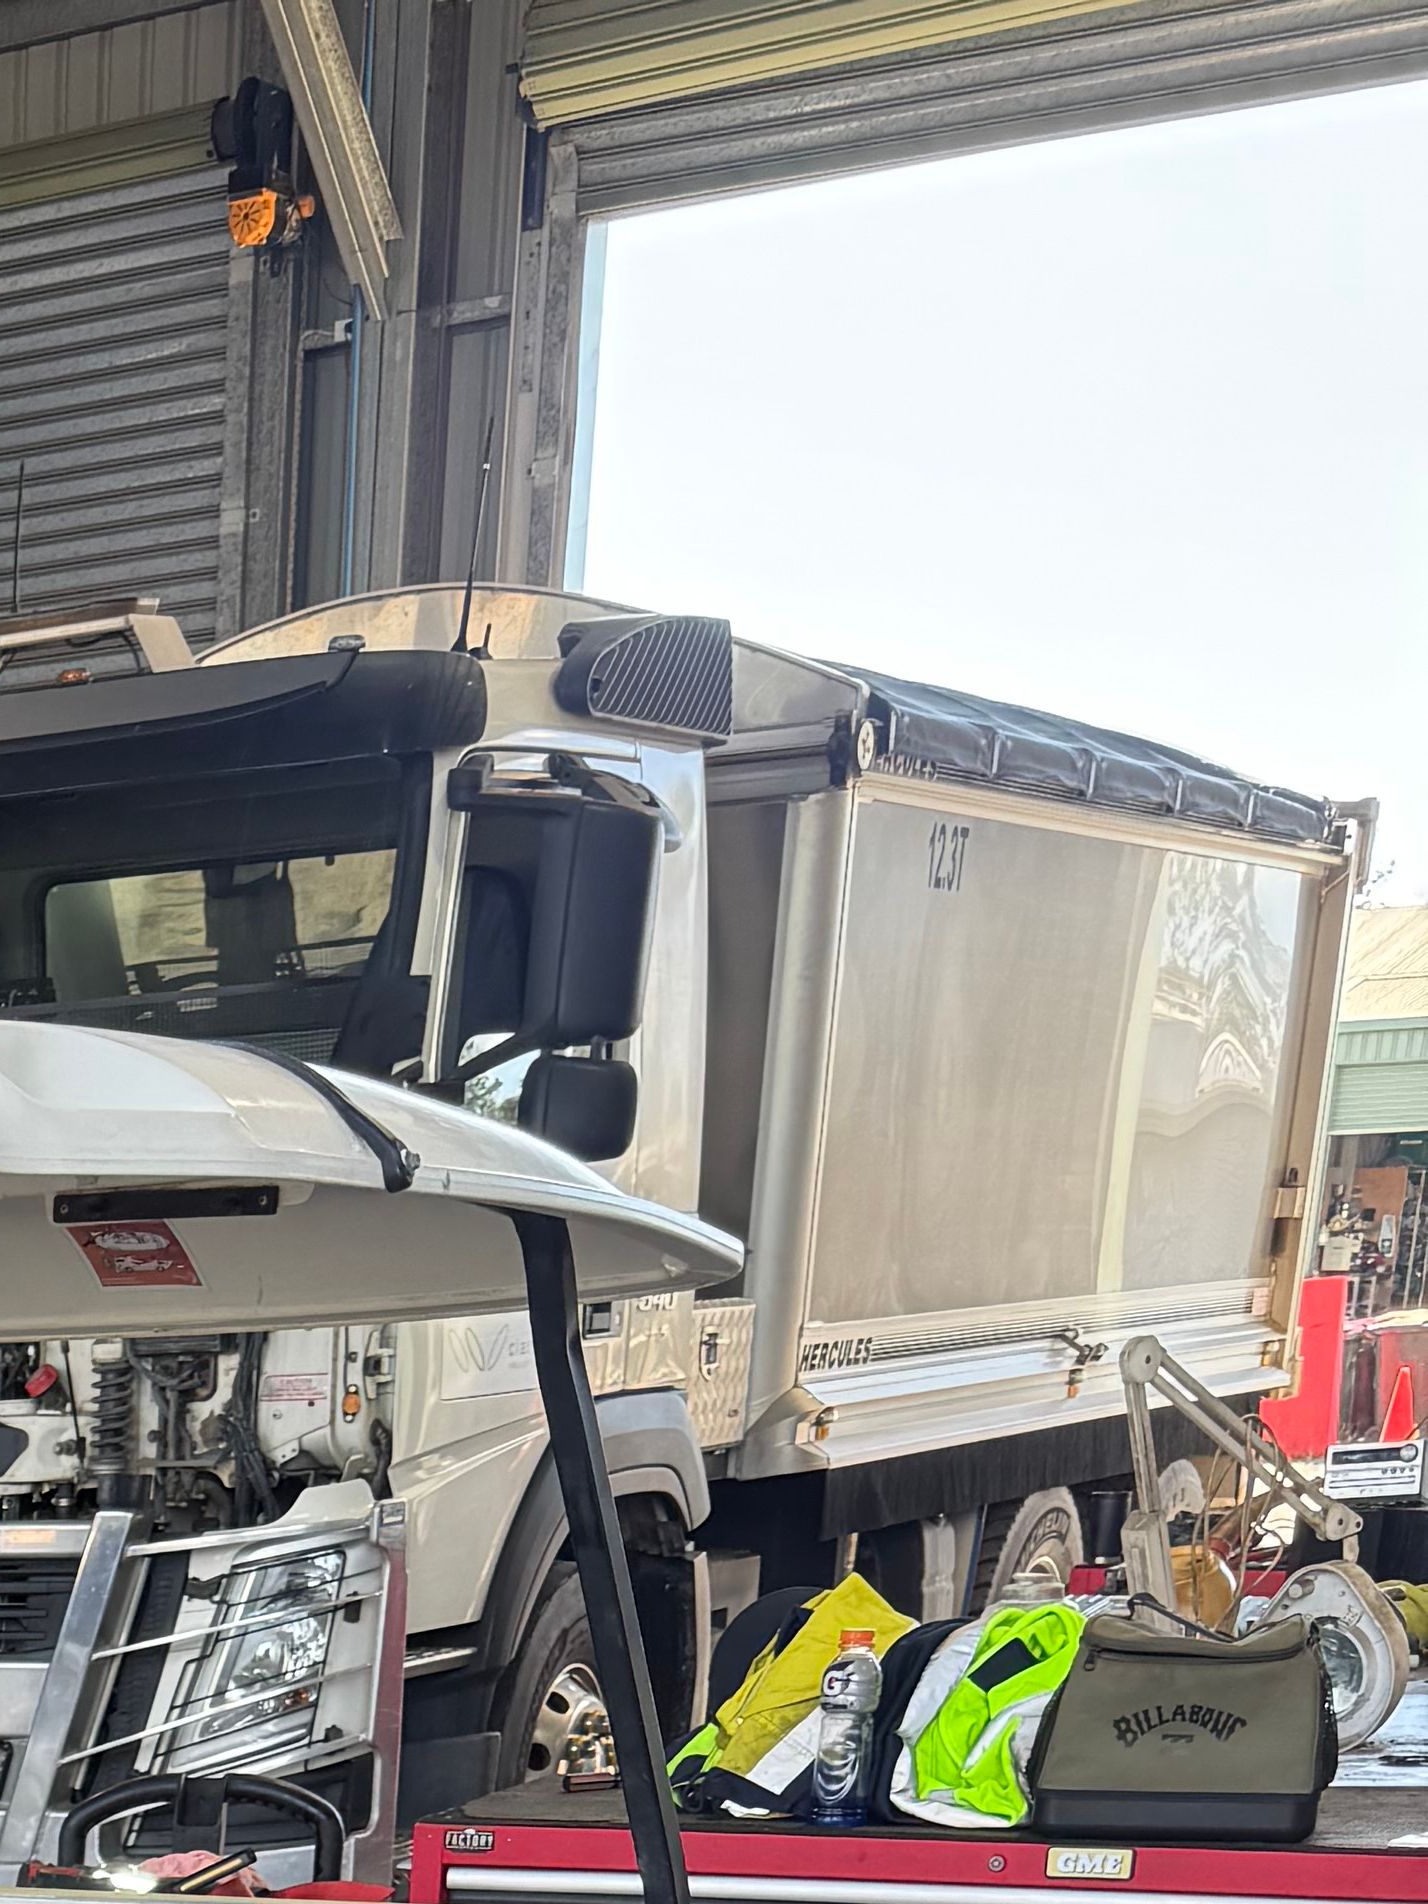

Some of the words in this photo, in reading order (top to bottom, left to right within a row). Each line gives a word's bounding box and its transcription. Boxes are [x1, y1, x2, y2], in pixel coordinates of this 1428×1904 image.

[798, 1336, 874, 1373] HERCULES
[445, 1832, 494, 1849] FACTORY
[1056, 1853, 1123, 1875] GME
